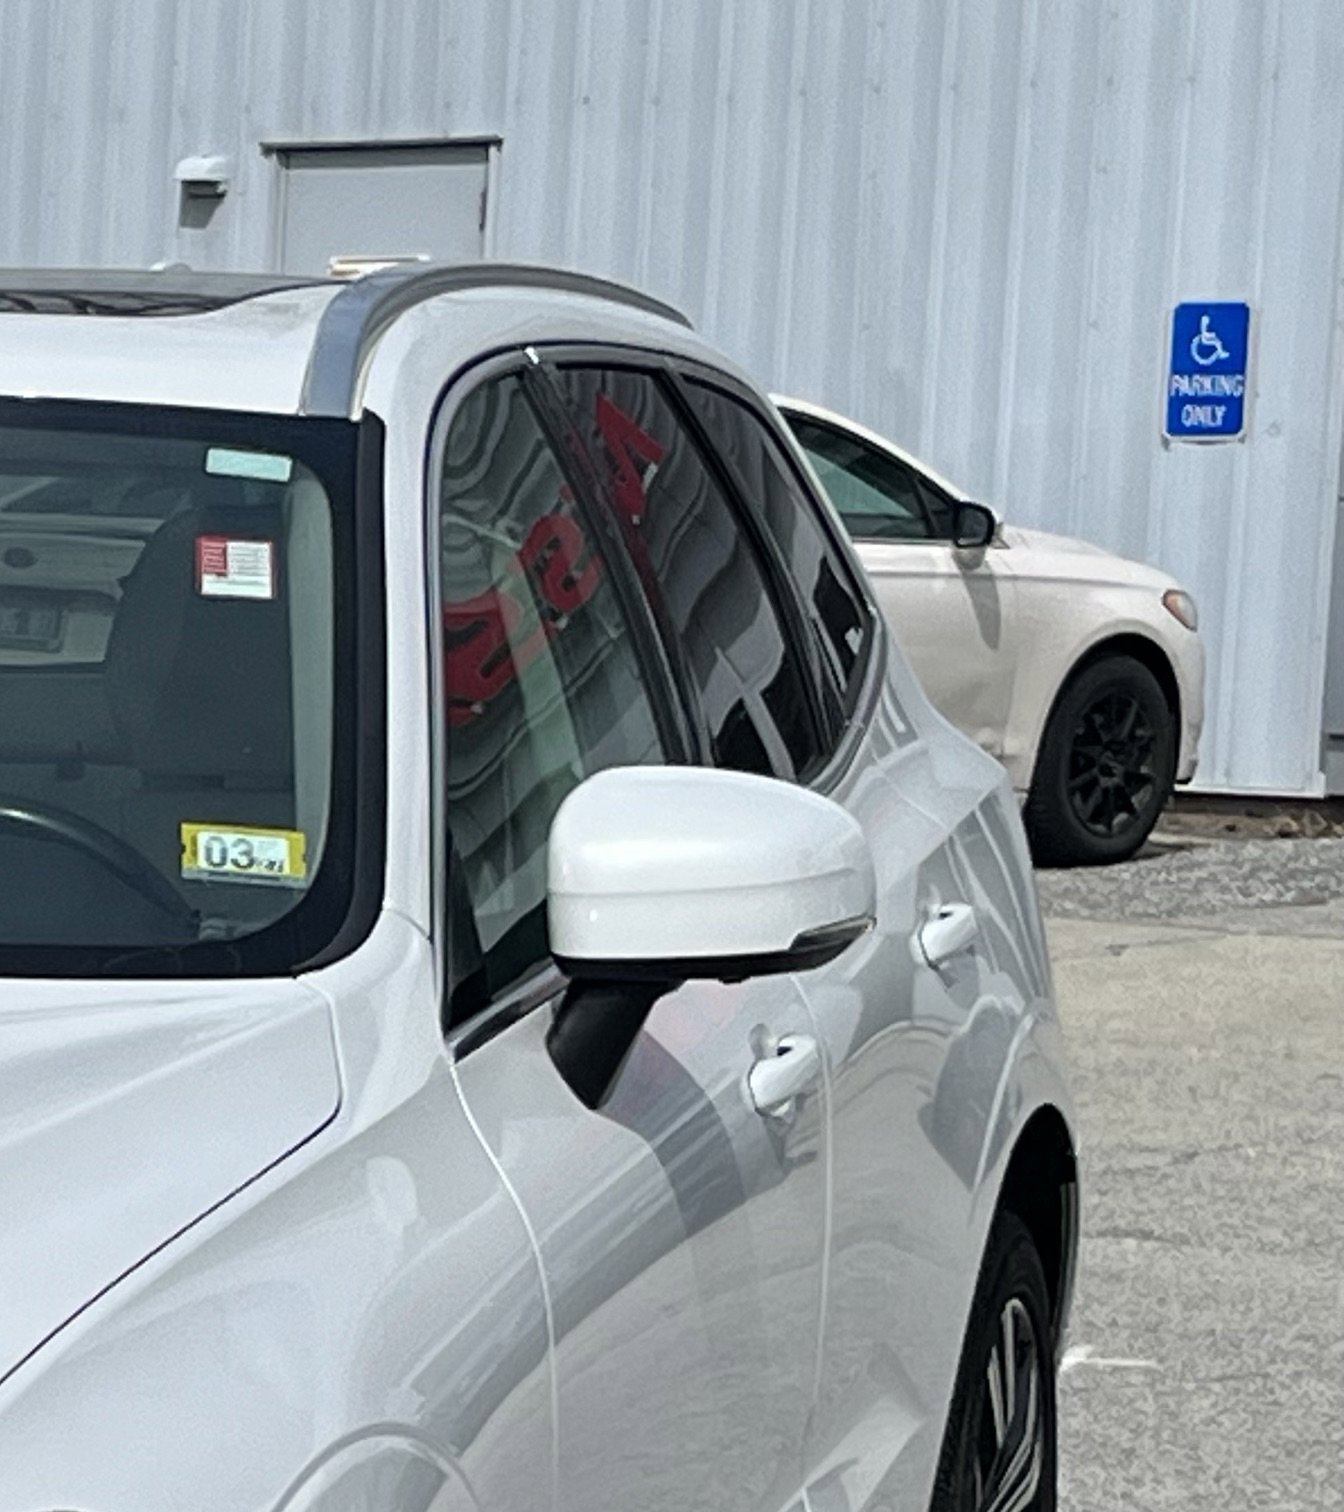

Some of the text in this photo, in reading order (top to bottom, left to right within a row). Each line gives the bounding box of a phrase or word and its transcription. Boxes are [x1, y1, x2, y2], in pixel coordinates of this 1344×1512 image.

[1170, 374, 1244, 397] PARKING
[1181, 404, 1227, 428] ONLY
[204, 835, 255, 869] 03
